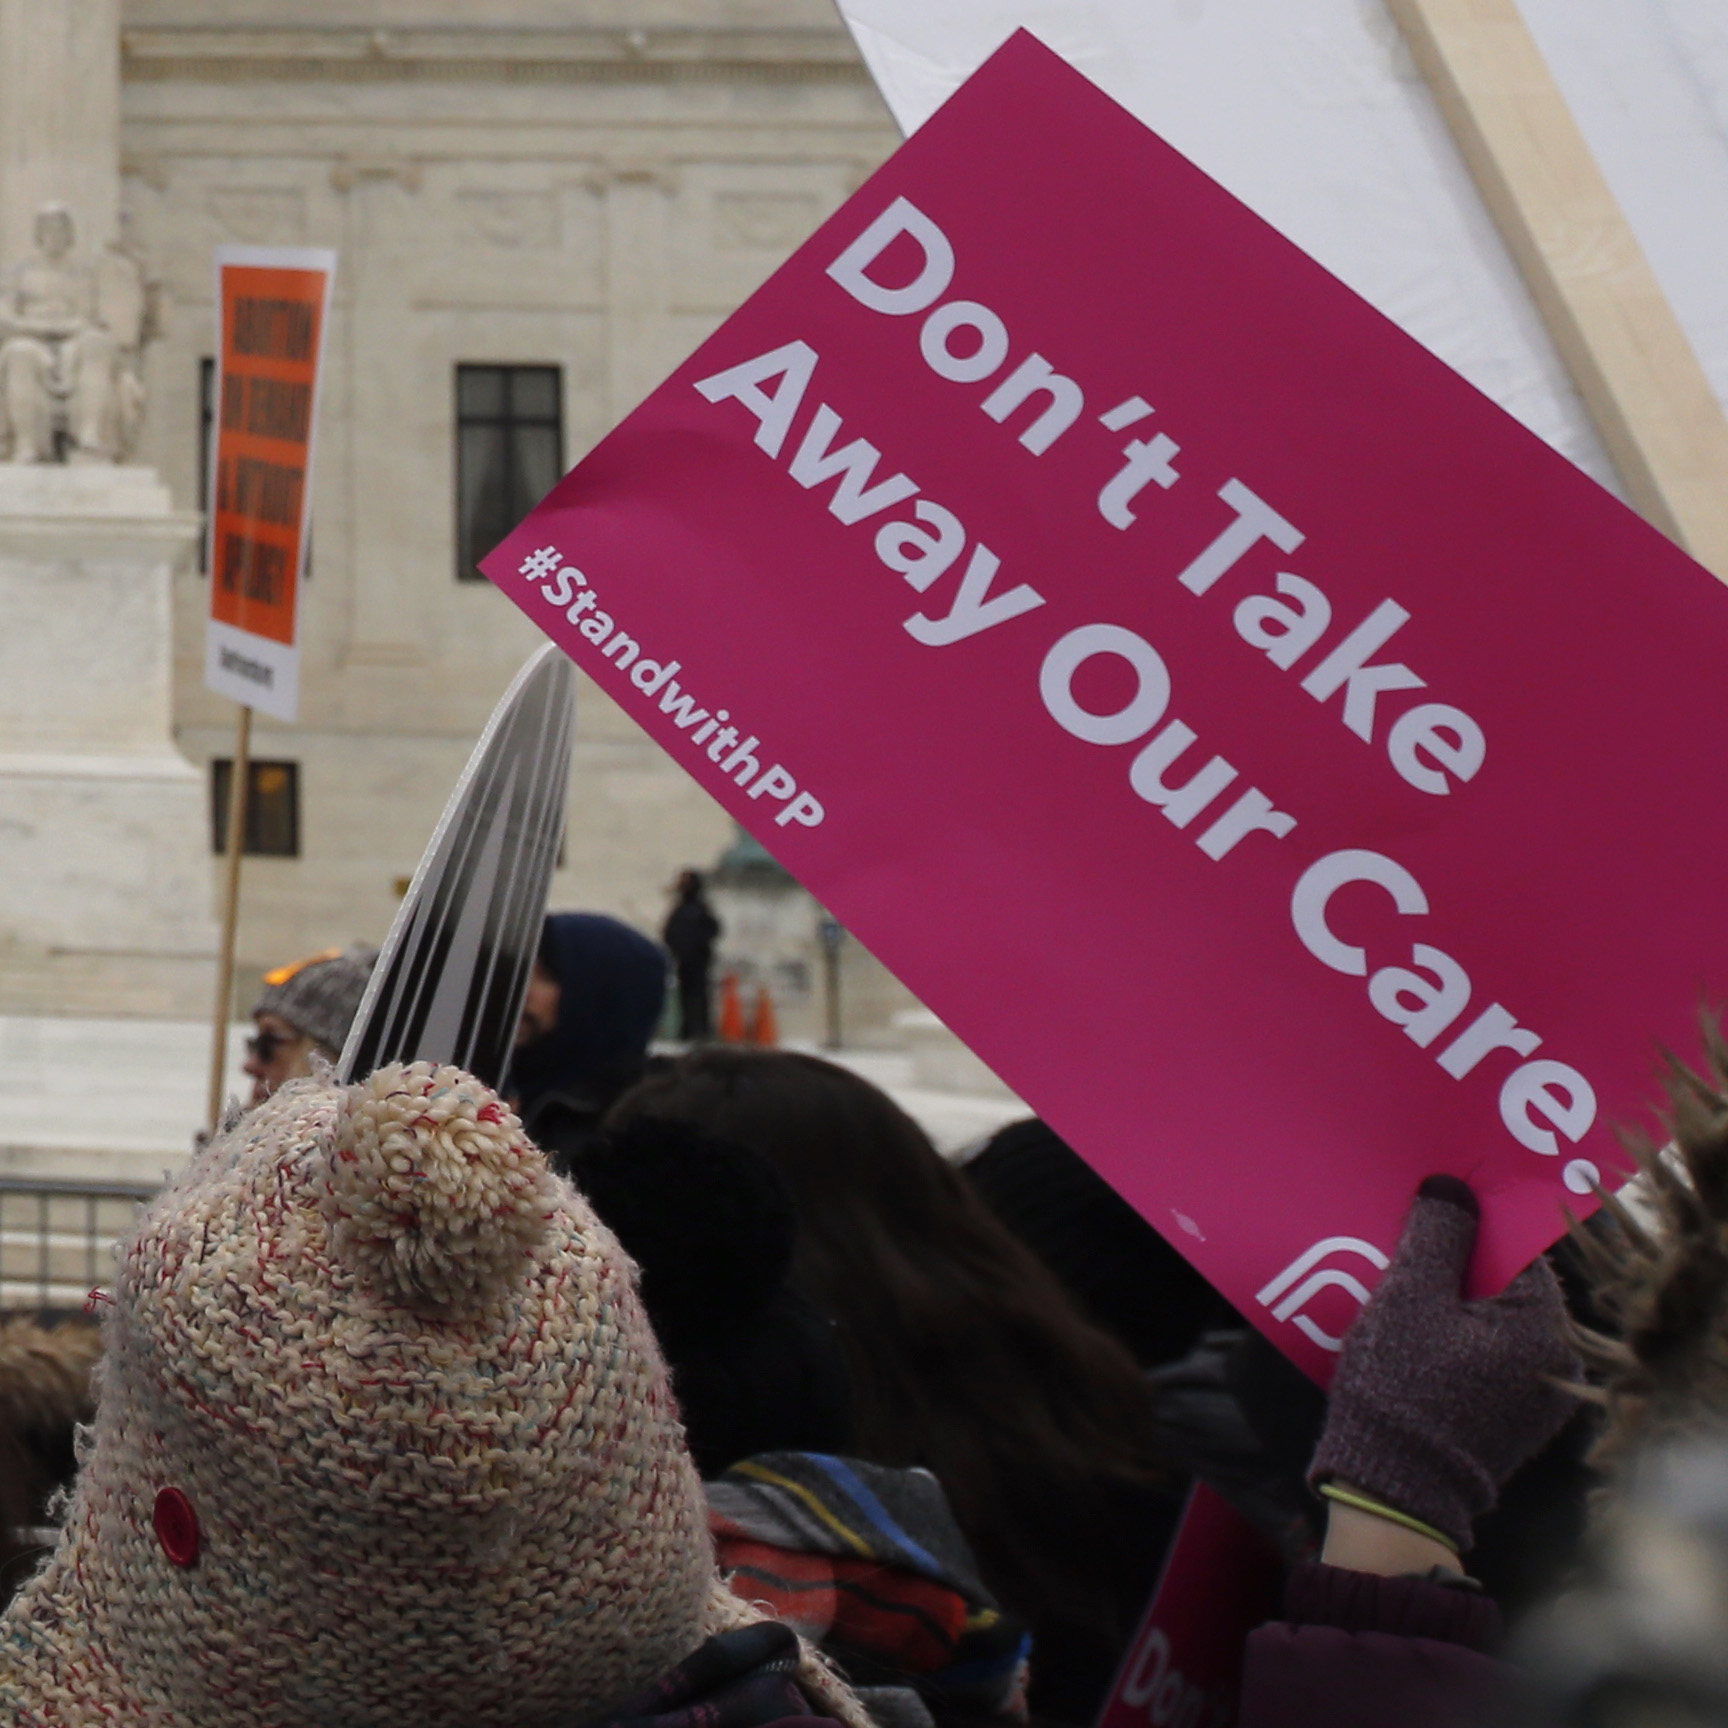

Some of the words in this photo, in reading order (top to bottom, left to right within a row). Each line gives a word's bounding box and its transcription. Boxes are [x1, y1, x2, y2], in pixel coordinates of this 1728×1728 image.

[518, 545, 826, 834] #StandwithPP
[693, 339, 1046, 647] Away
[1039, 622, 1297, 862] Our
[1291, 849, 1601, 1194] Care.
[827, 195, 1180, 532] Don't
[1178, 479, 1487, 796] Take
